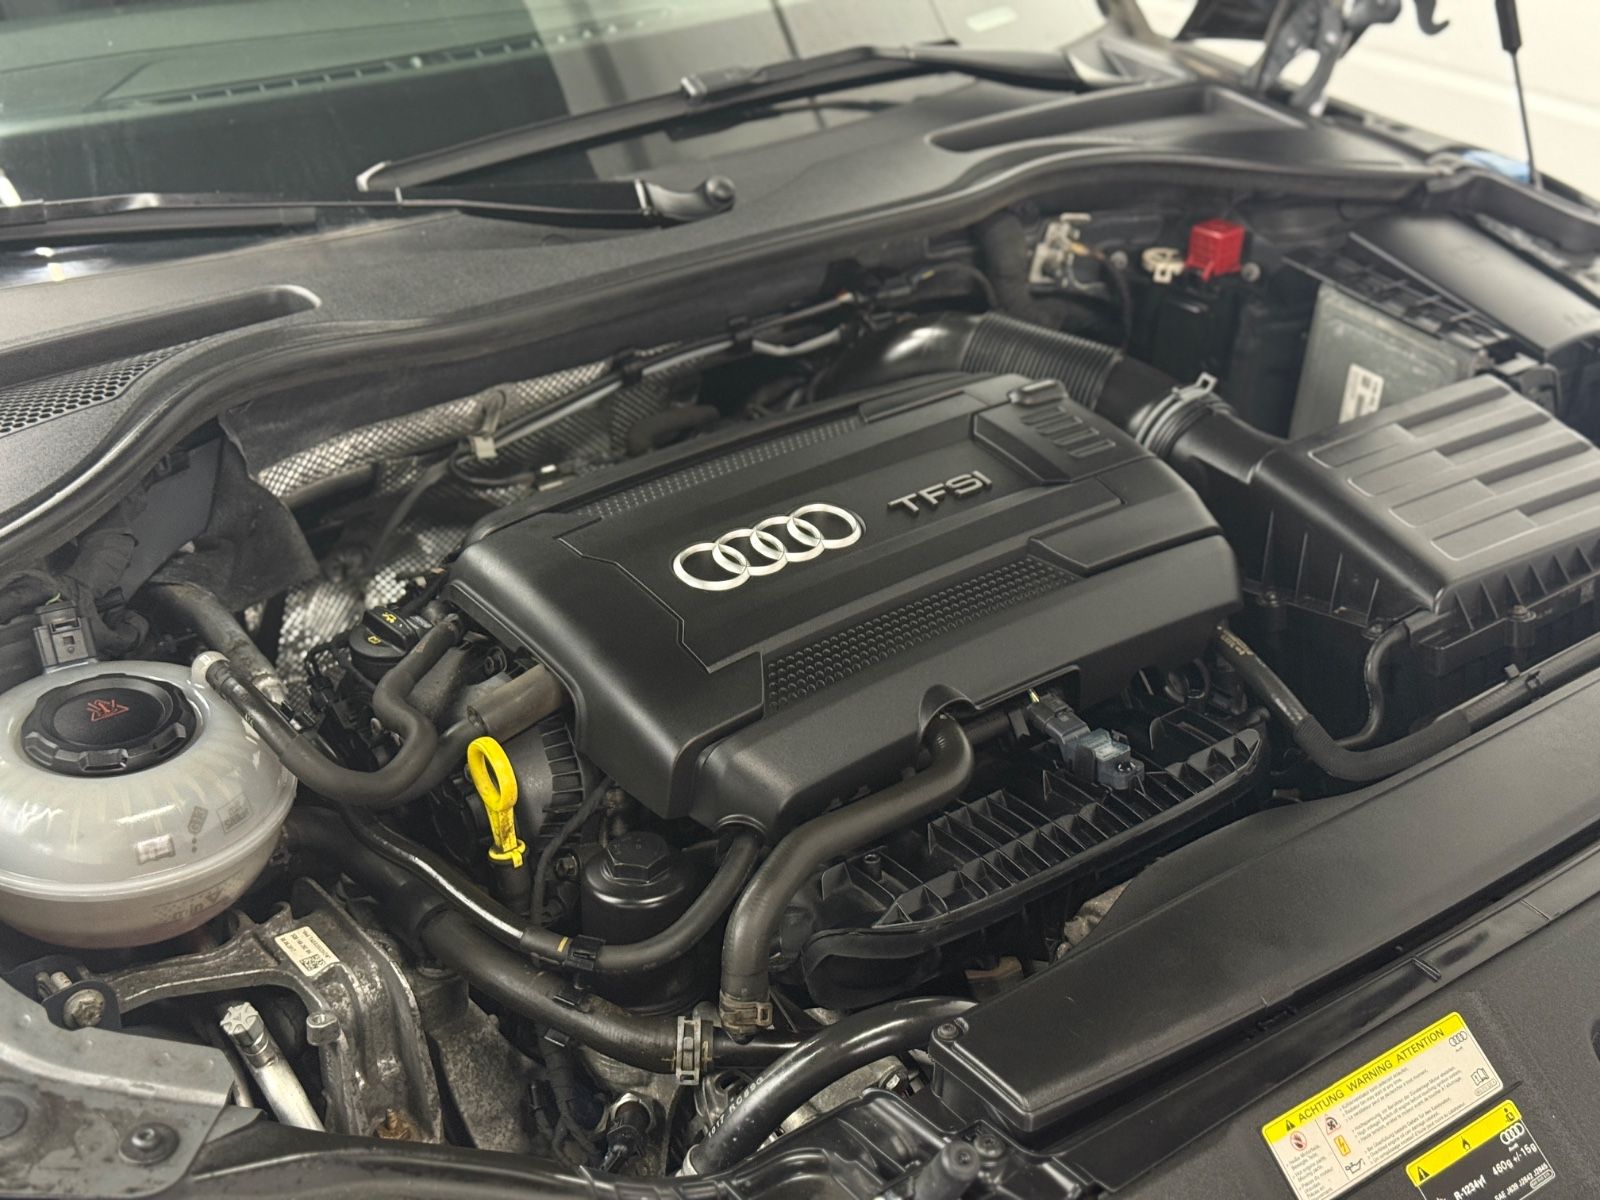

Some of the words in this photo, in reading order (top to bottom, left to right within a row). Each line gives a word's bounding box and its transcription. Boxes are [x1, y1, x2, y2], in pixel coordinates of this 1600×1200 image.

[887, 470, 993, 514] TFSI
[1297, 1089, 1344, 1123] ACHTUNG
[1347, 1060, 1393, 1092] WARNING
[1396, 1028, 1445, 1063] ATTENTION
[1453, 1174, 1487, 1200] R-1234yf
[1492, 1158, 1514, 1176] 460g
